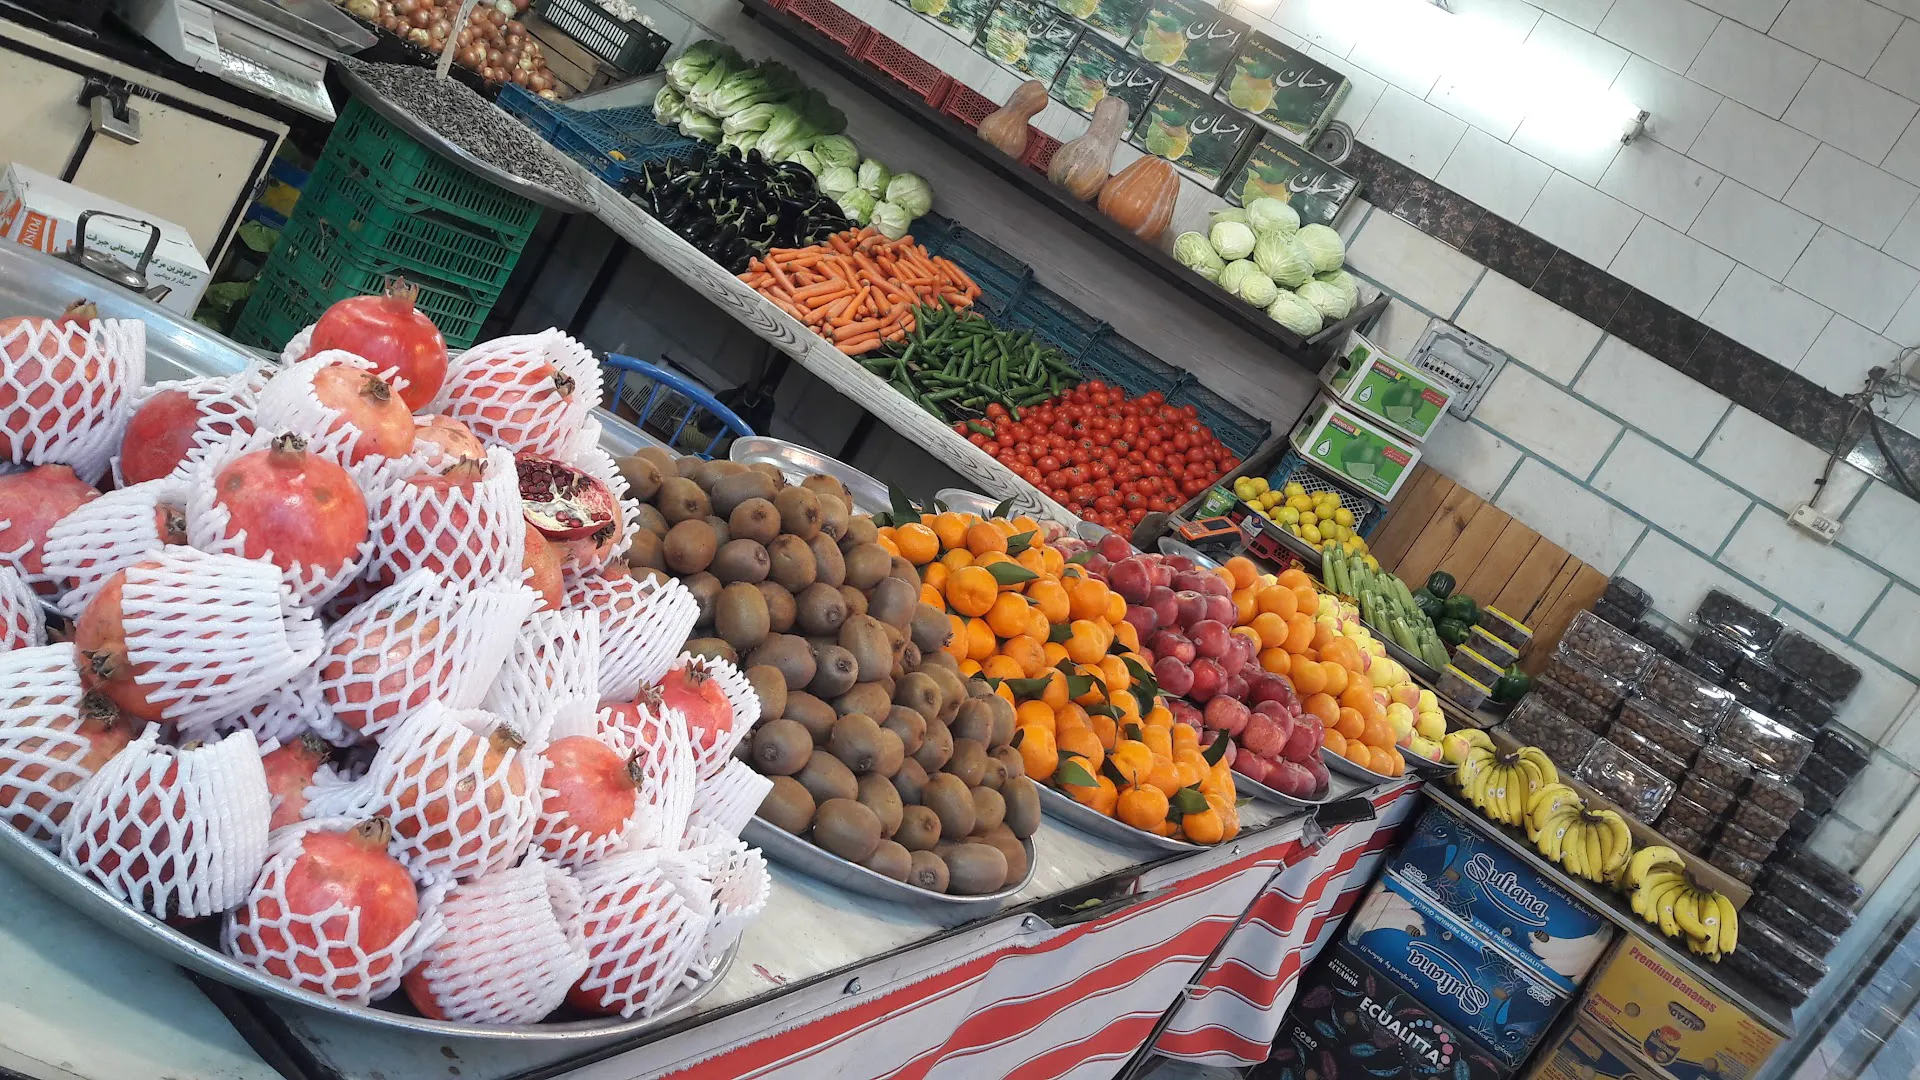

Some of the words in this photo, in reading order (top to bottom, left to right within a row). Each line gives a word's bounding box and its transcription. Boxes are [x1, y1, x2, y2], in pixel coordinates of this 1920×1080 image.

[1185, 19, 1242, 48] احسان
[1106, 66, 1160, 97] احسان
[1275, 67, 1335, 99] احسان
[1190, 113, 1247, 144] احسان
[1464, 853, 1549, 921] Sultana
[1411, 897, 1435, 916] QUALITY
[1434, 914, 1460, 935] PREMIUM
[1460, 932, 1480, 948] EXTRA
[1475, 920, 1494, 937] EXTRA
[1494, 933, 1520, 955] PREMIUM
[1520, 951, 1546, 971] QUALITY
[1326, 961, 1359, 986] ECUADOR
[1406, 948, 1490, 1016] Sultana
[1593, 993, 1622, 1015] PRODUCT
[1358, 996, 1441, 1066] ECUALITTA
